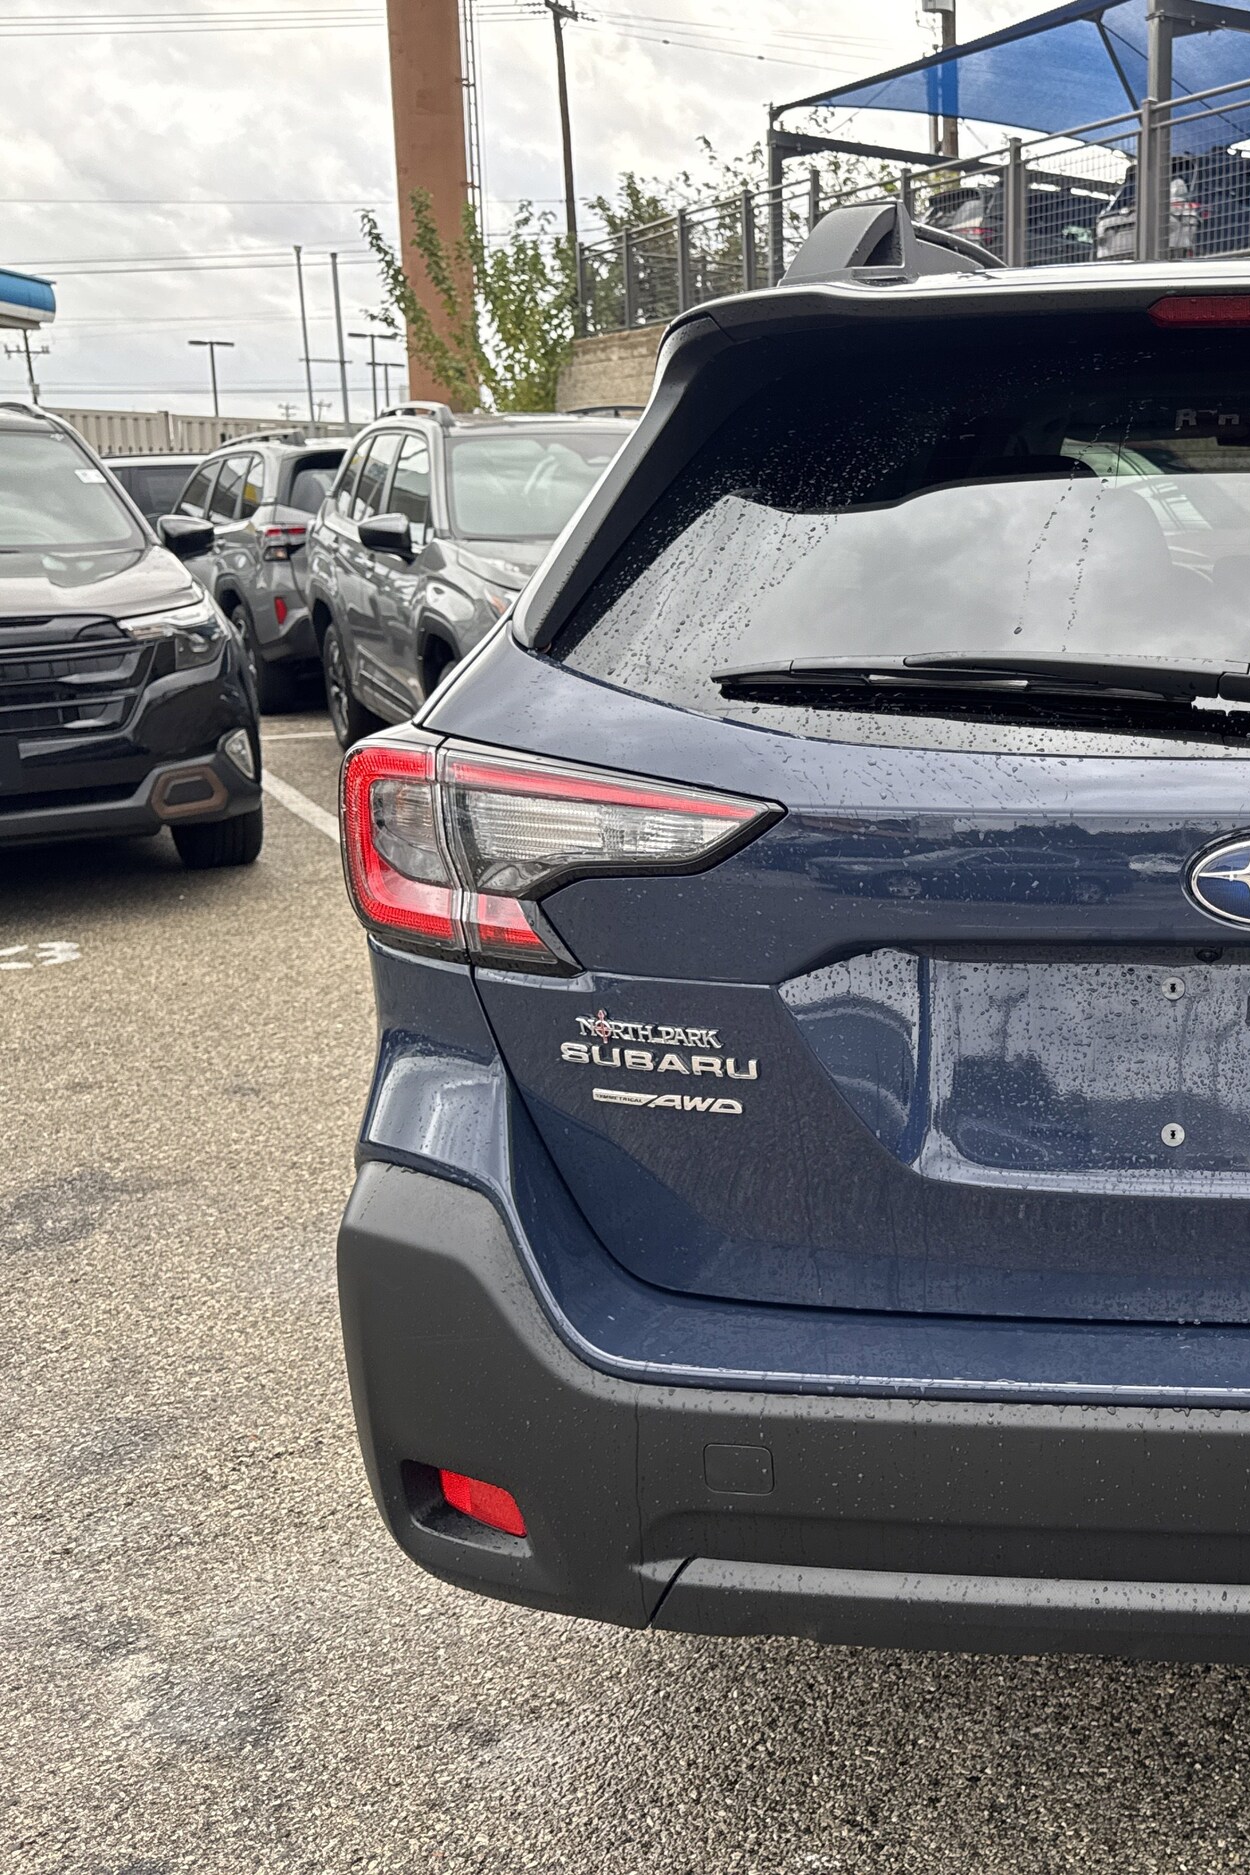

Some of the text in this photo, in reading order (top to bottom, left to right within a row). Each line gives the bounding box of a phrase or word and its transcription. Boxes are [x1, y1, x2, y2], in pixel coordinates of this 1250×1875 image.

[575, 1012, 723, 1049] NORTH PARK
[561, 1041, 759, 1080] SUBARU
[648, 1094, 743, 1114] AWD
